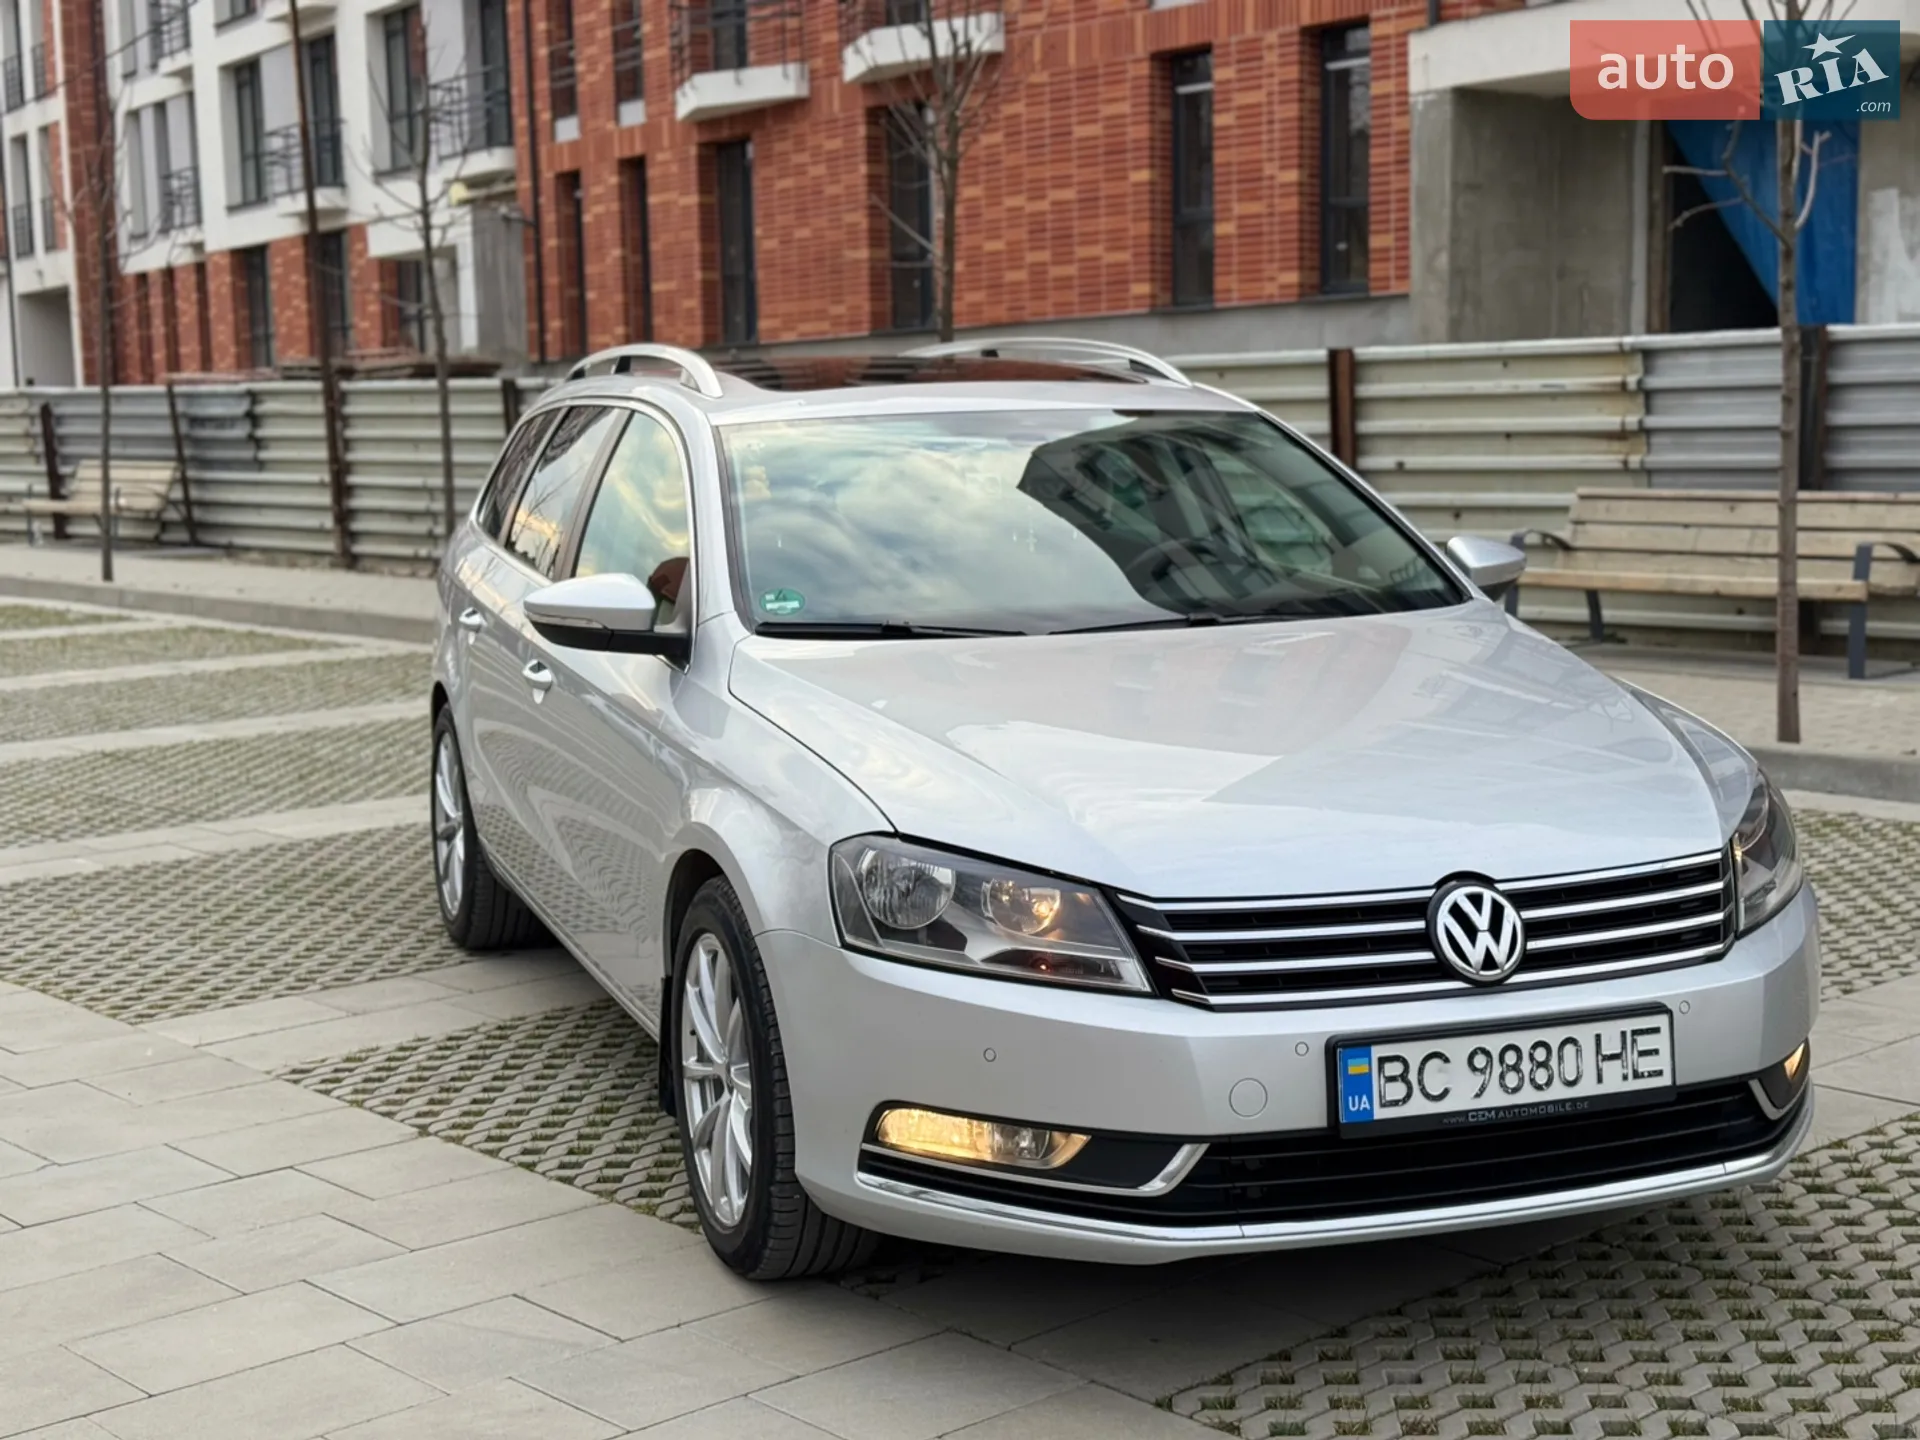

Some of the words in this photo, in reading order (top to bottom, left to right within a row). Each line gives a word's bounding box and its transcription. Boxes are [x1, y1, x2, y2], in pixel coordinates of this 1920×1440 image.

[1377, 1051, 1452, 1108] BC
[1466, 1036, 1584, 1099] 9880
[1594, 1026, 1664, 1085] HE
[1348, 1094, 1371, 1112] UA
